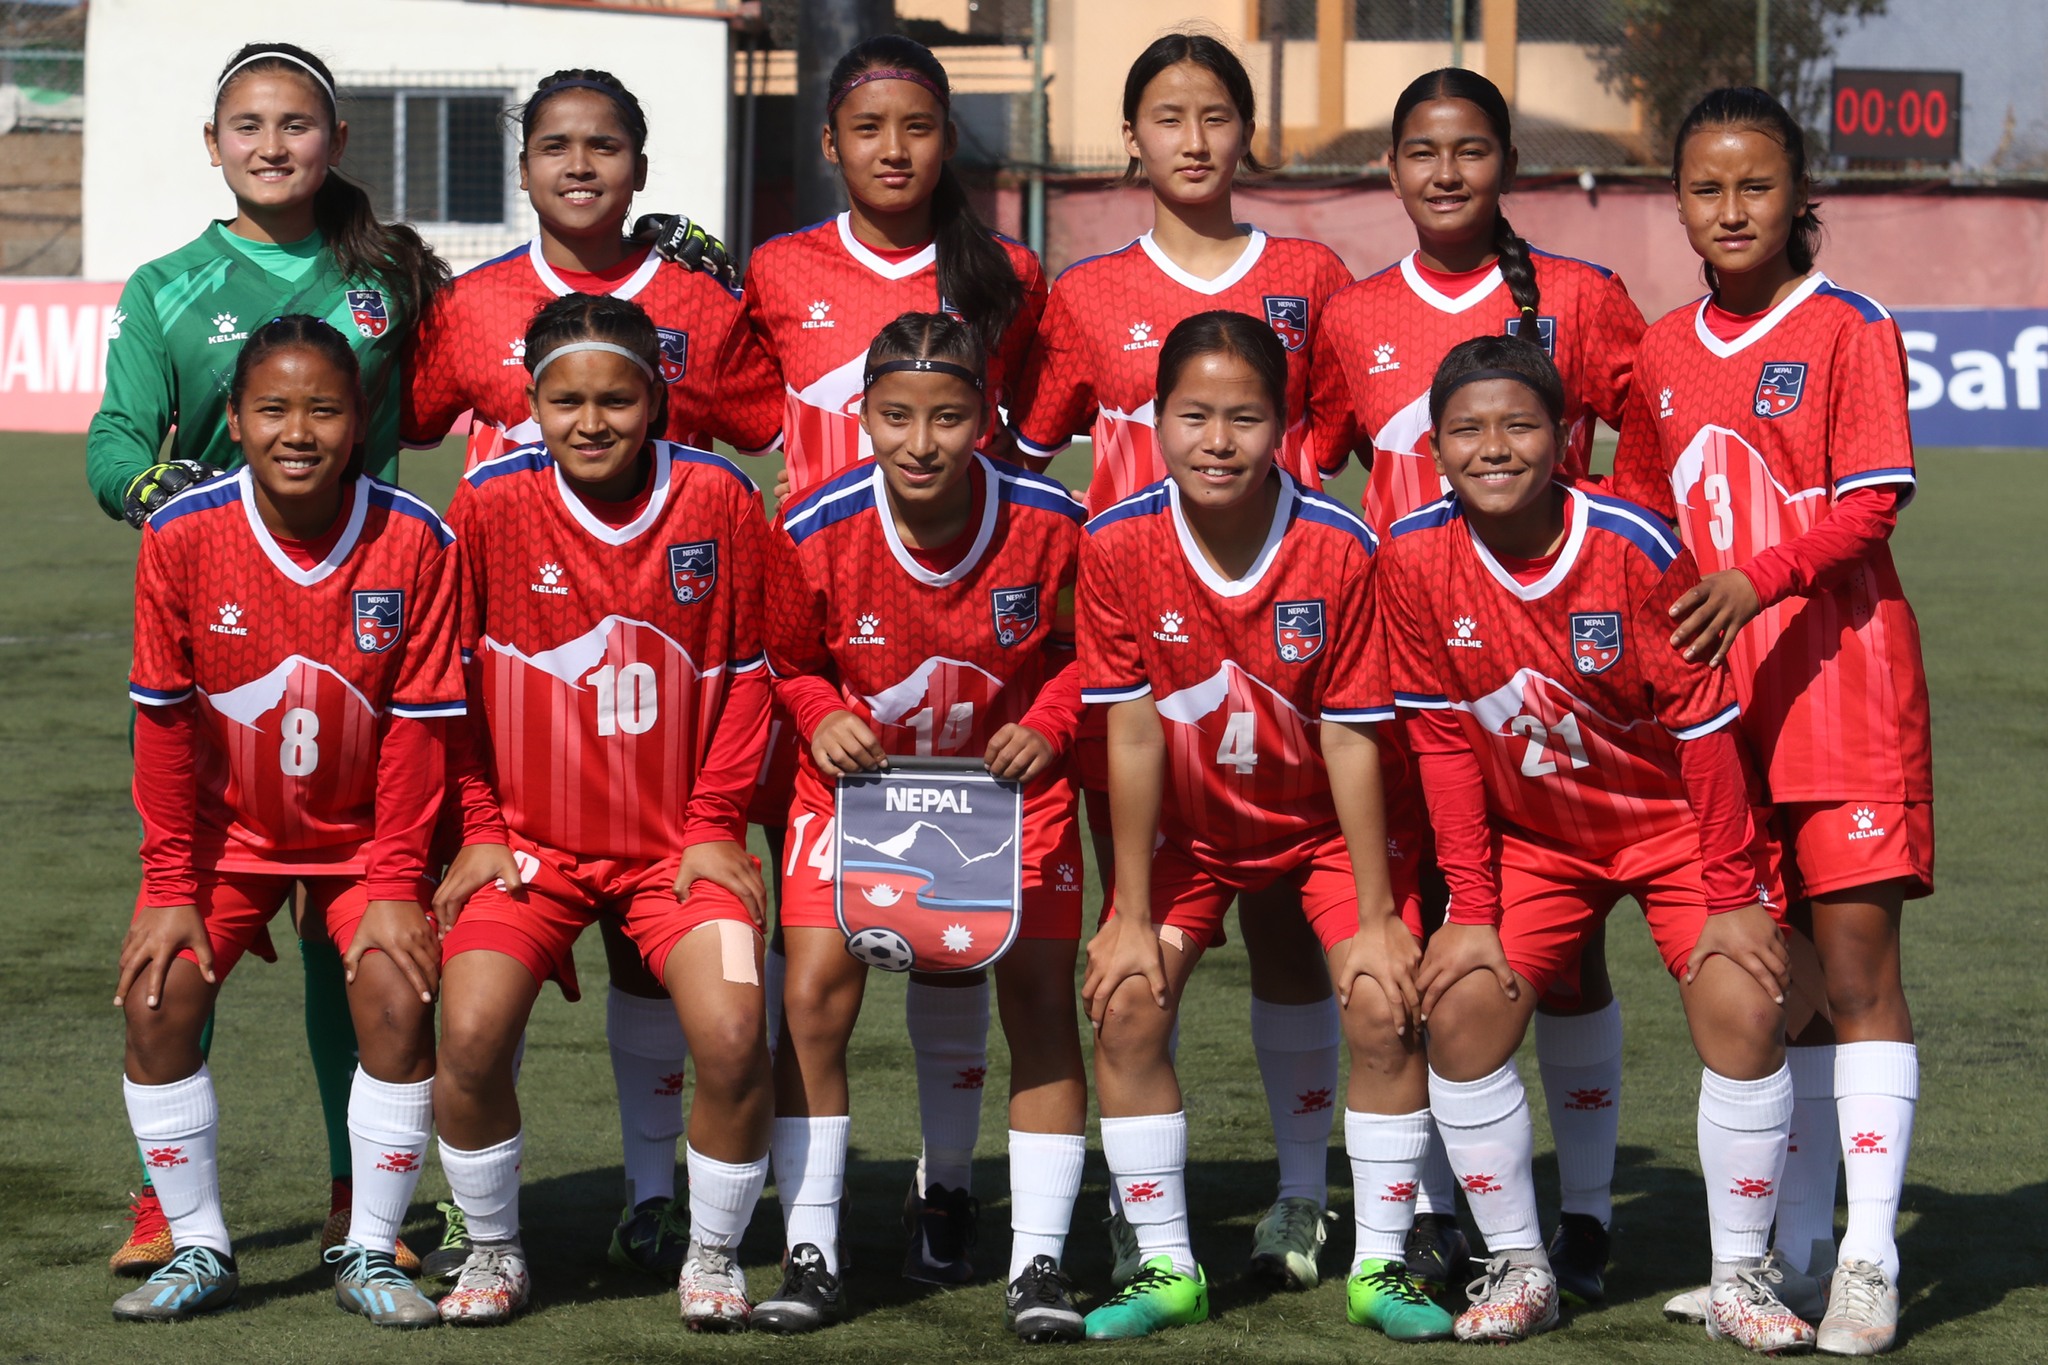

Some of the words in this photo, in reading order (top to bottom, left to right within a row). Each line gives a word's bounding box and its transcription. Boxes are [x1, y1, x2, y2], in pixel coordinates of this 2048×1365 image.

[1835, 87, 1948, 138] 00:00
[670, 216, 690, 248] KELM
[1277, 301, 1297, 309] NEPAL
[802, 320, 835, 329] KELME
[208, 332, 249, 344] KELME
[0, 304, 118, 393] AM
[1123, 340, 1160, 351] KELME
[502, 357, 525, 366] KEL
[1369, 362, 1401, 375] KELME
[1773, 367, 1793, 375] NEPAL
[1900, 326, 2048, 411] Saf
[1702, 473, 1735, 551] 3
[682, 547, 704, 557] NEPAL
[531, 583, 569, 595] KELME
[367, 596, 391, 604] NEPAL
[1006, 592, 1027, 602] NEPAL
[1287, 606, 1310, 615] NEPAL
[1583, 618, 1606, 627] NEPAL
[209, 624, 248, 636] KELME
[848, 636, 885, 645] KELME
[1153, 630, 1189, 643] KELME
[1446, 638, 1483, 649] KELME
[587, 662, 657, 737] 10
[280, 707, 320, 777] 8
[1216, 711, 1259, 775] 4
[1510, 711, 1590, 779] 21
[886, 788, 973, 814] NEPAL
[1848, 827, 1885, 841] KELME
[786, 811, 837, 882] 14
[1564, 1099, 1614, 1111] KELME
[1848, 1146, 1889, 1156] KELME
[146, 1156, 189, 1169] KELME
[376, 1162, 420, 1173] KELME
[1123, 1190, 1164, 1203] KELME
[1729, 1187, 1775, 1199] KELME
